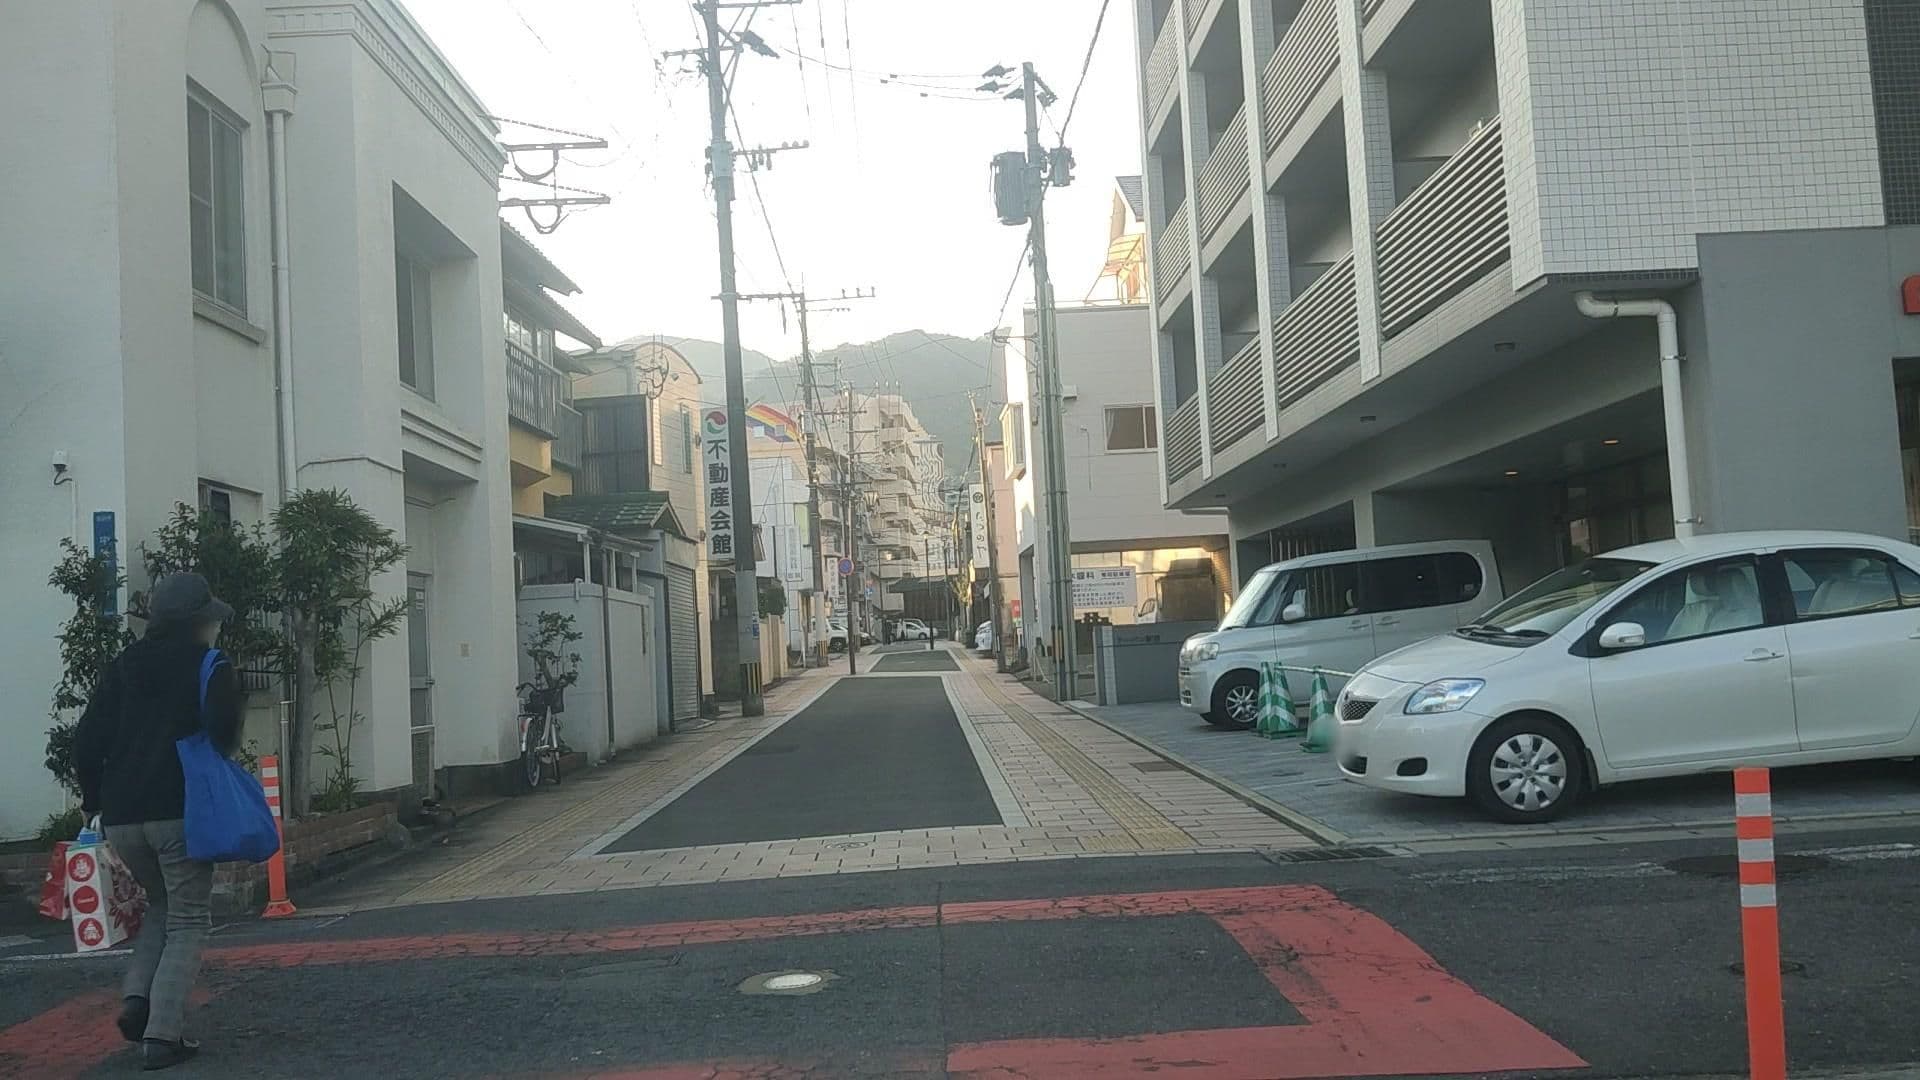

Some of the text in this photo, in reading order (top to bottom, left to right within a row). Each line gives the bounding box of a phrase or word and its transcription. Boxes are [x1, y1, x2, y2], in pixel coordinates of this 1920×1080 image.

[707, 438, 732, 555] 不動産会館
